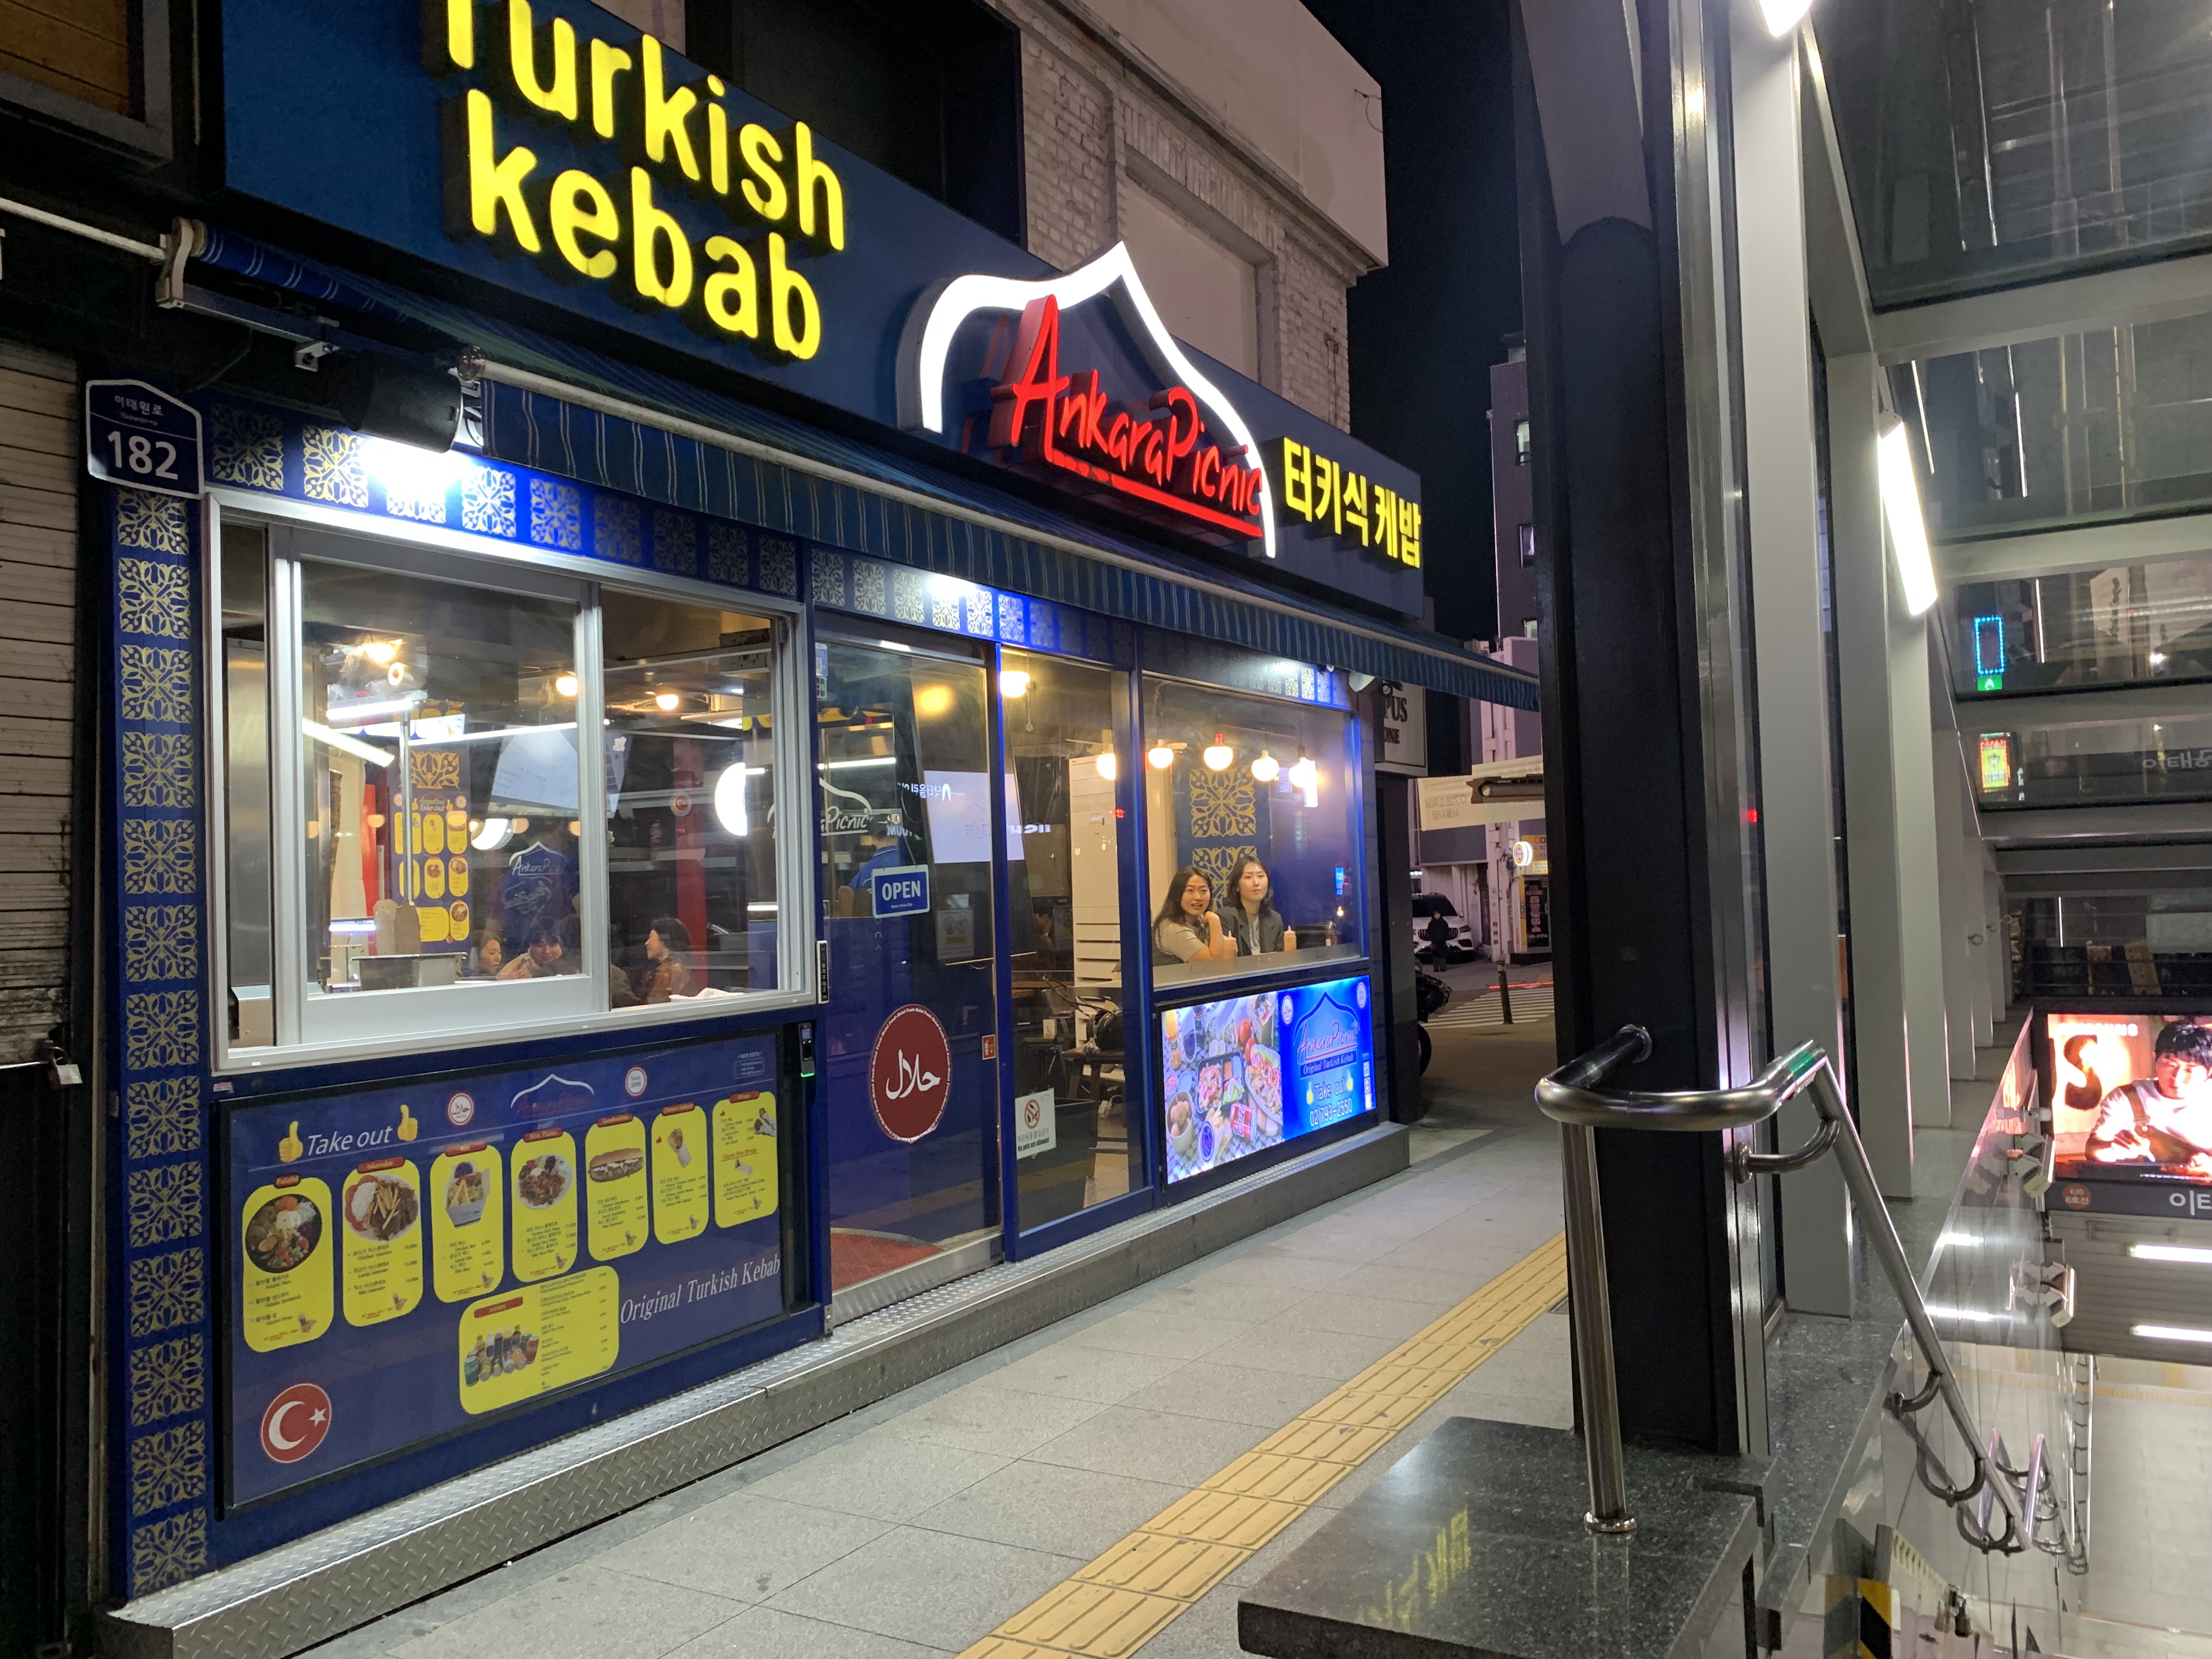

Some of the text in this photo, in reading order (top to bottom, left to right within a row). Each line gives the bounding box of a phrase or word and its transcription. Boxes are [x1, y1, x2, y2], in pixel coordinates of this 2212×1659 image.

[467, 88, 821, 360] kebab
[114, 394, 164, 416] 이태원로
[108, 431, 179, 480] 182
[1284, 437, 1422, 569] 터키식 케밥
[882, 880, 921, 901] OPEN
[885, 1048, 941, 1101] حلال
[1303, 1052, 1354, 1075] Original Turkish Kebab
[1315, 1077, 1346, 1102] Take out
[308, 1125, 393, 1156] Take out
[2065, 1196, 2090, 1205] 6호선
[2069, 1188, 2084, 1196] 630
[620, 1253, 781, 1324] Original Turkish Kebab
